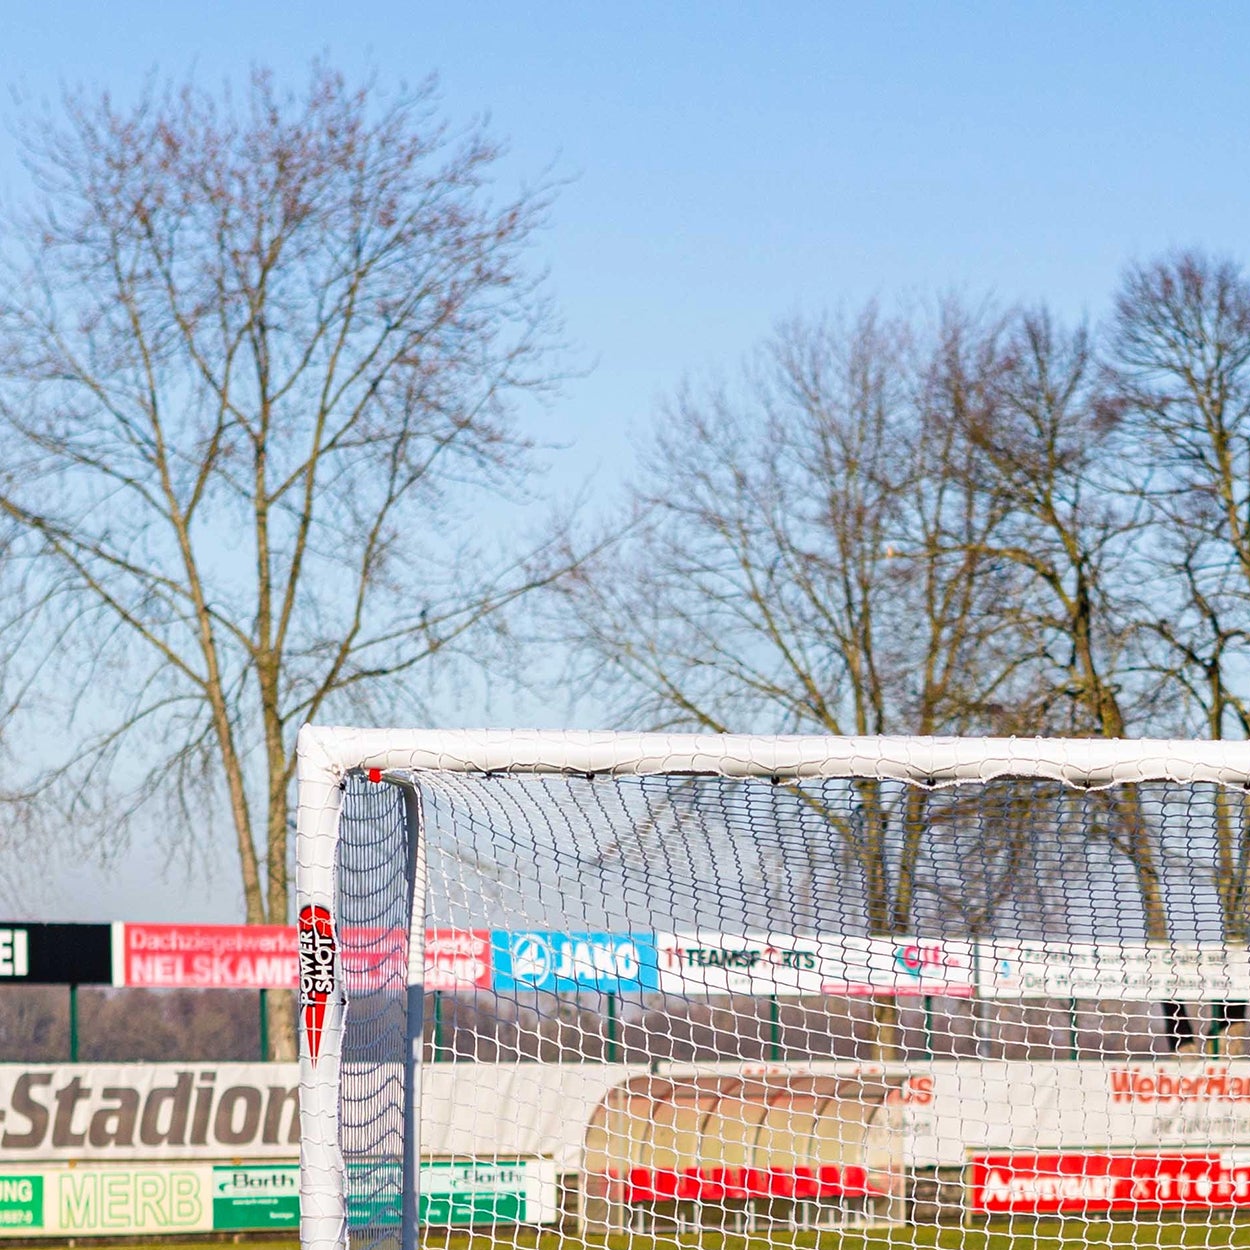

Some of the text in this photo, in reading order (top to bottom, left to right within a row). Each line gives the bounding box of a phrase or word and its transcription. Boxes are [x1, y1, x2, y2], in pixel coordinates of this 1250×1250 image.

[315, 937, 333, 994] SHOT
[556, 942, 639, 980] JAKO
[58, 1171, 202, 1229] MERB
[232, 1173, 294, 1188] Barth
